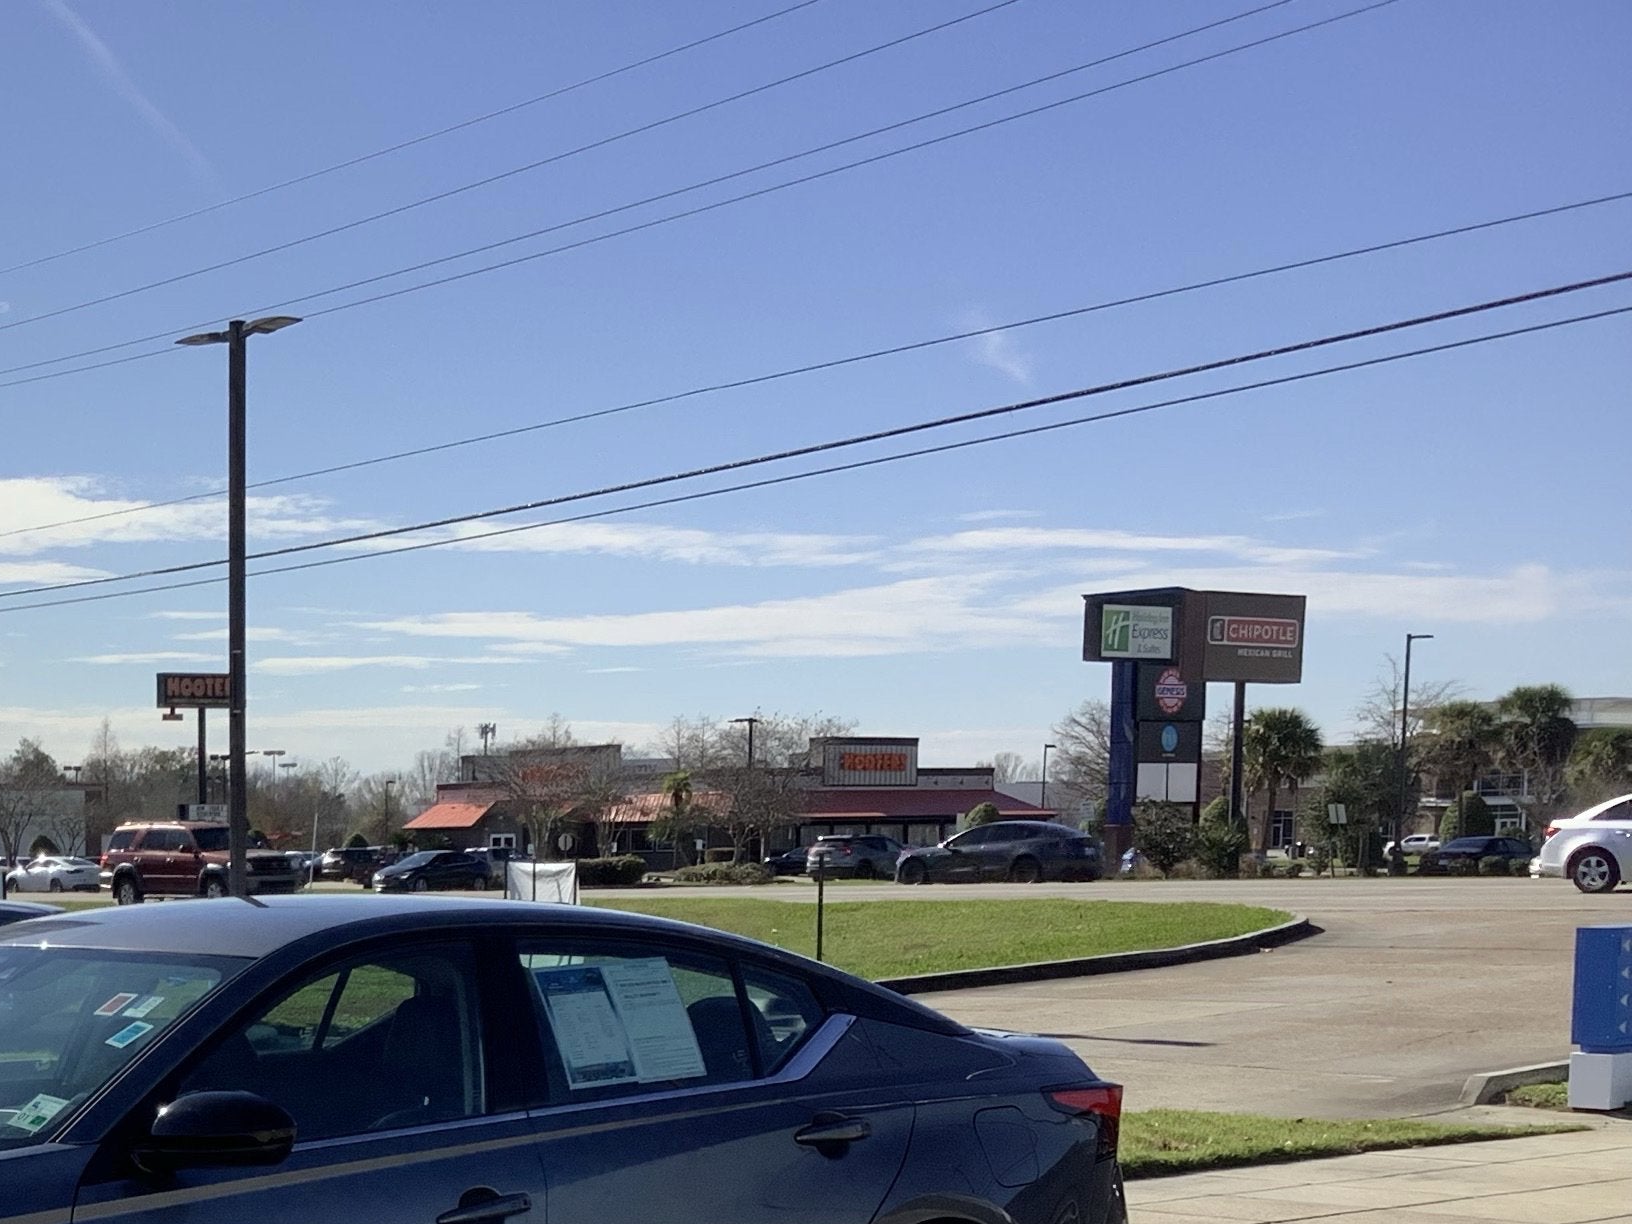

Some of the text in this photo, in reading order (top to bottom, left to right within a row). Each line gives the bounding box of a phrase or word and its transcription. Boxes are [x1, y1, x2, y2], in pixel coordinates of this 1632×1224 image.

[1132, 623, 1169, 642] Express
[1229, 624, 1294, 640] CHIPOTLE
[1237, 648, 1293, 658] MEXICAN GRILL
[842, 752, 907, 771] HOOTERS
